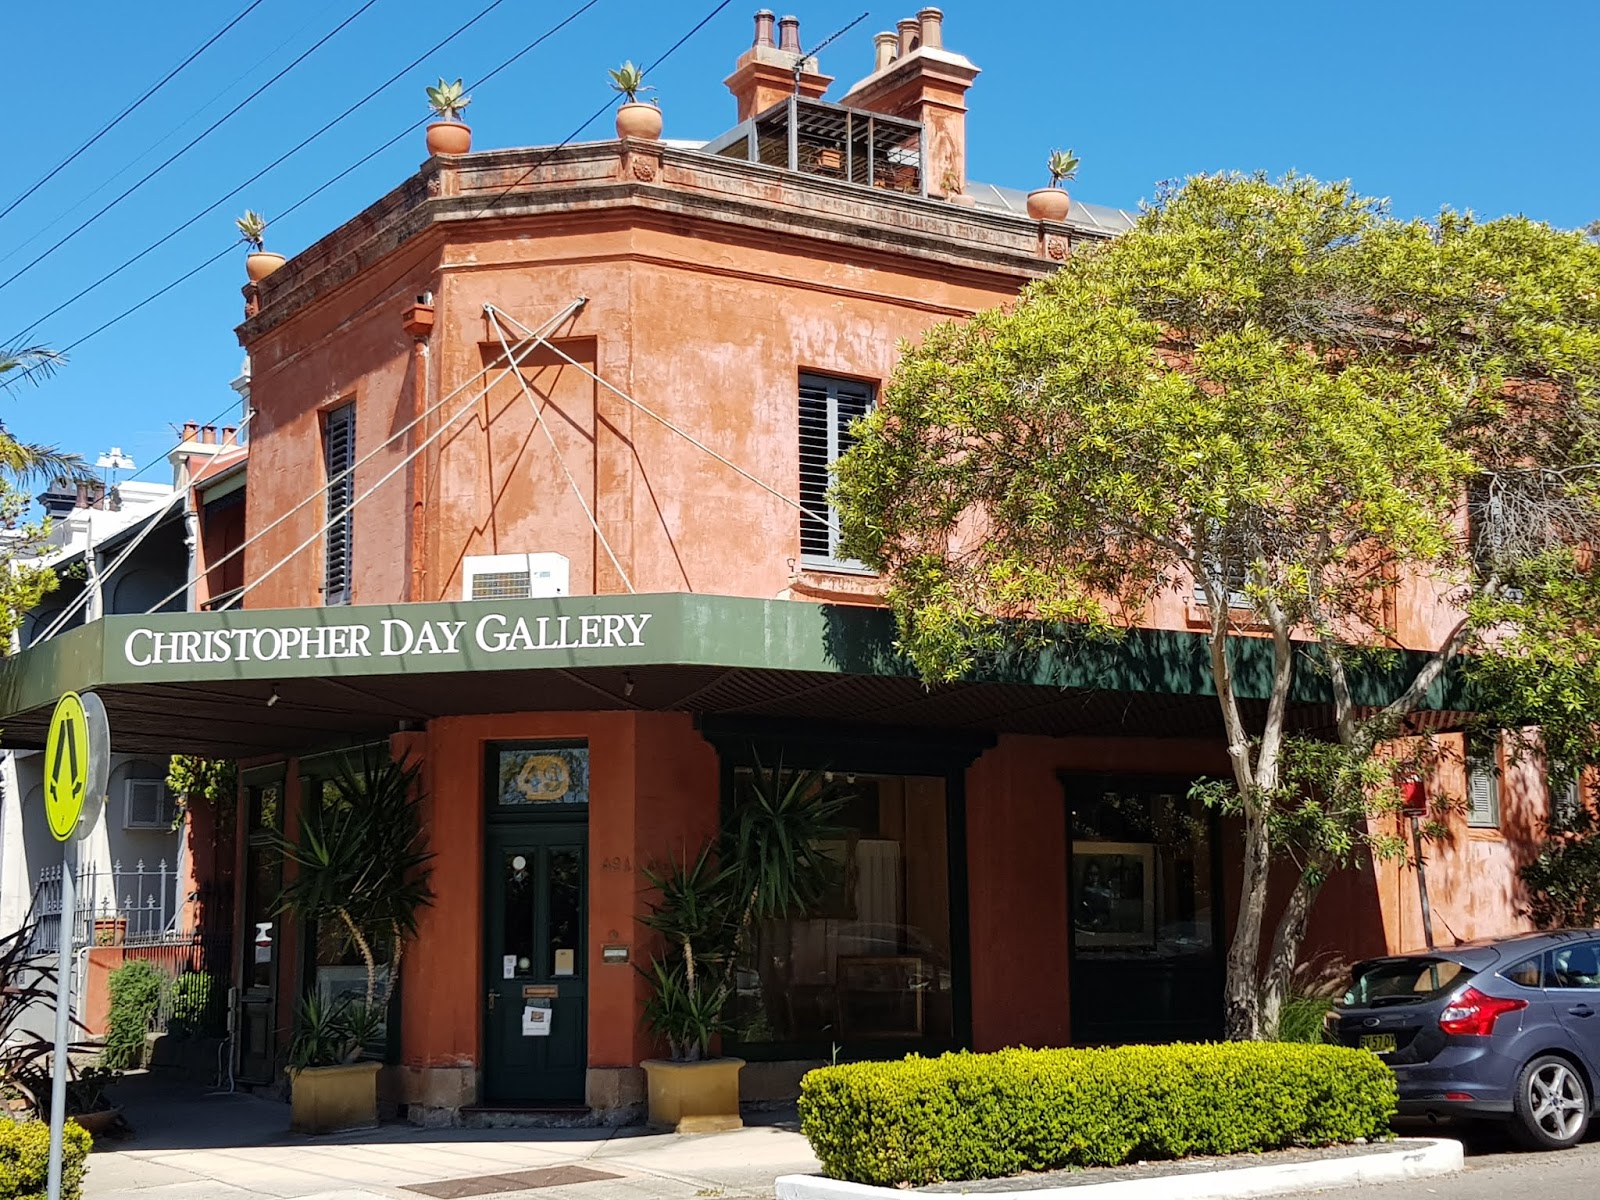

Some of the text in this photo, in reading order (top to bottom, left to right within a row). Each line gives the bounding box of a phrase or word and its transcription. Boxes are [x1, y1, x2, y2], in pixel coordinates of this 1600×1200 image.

[124, 613, 652, 666] CHRISTOPHER DAY GALLERY
